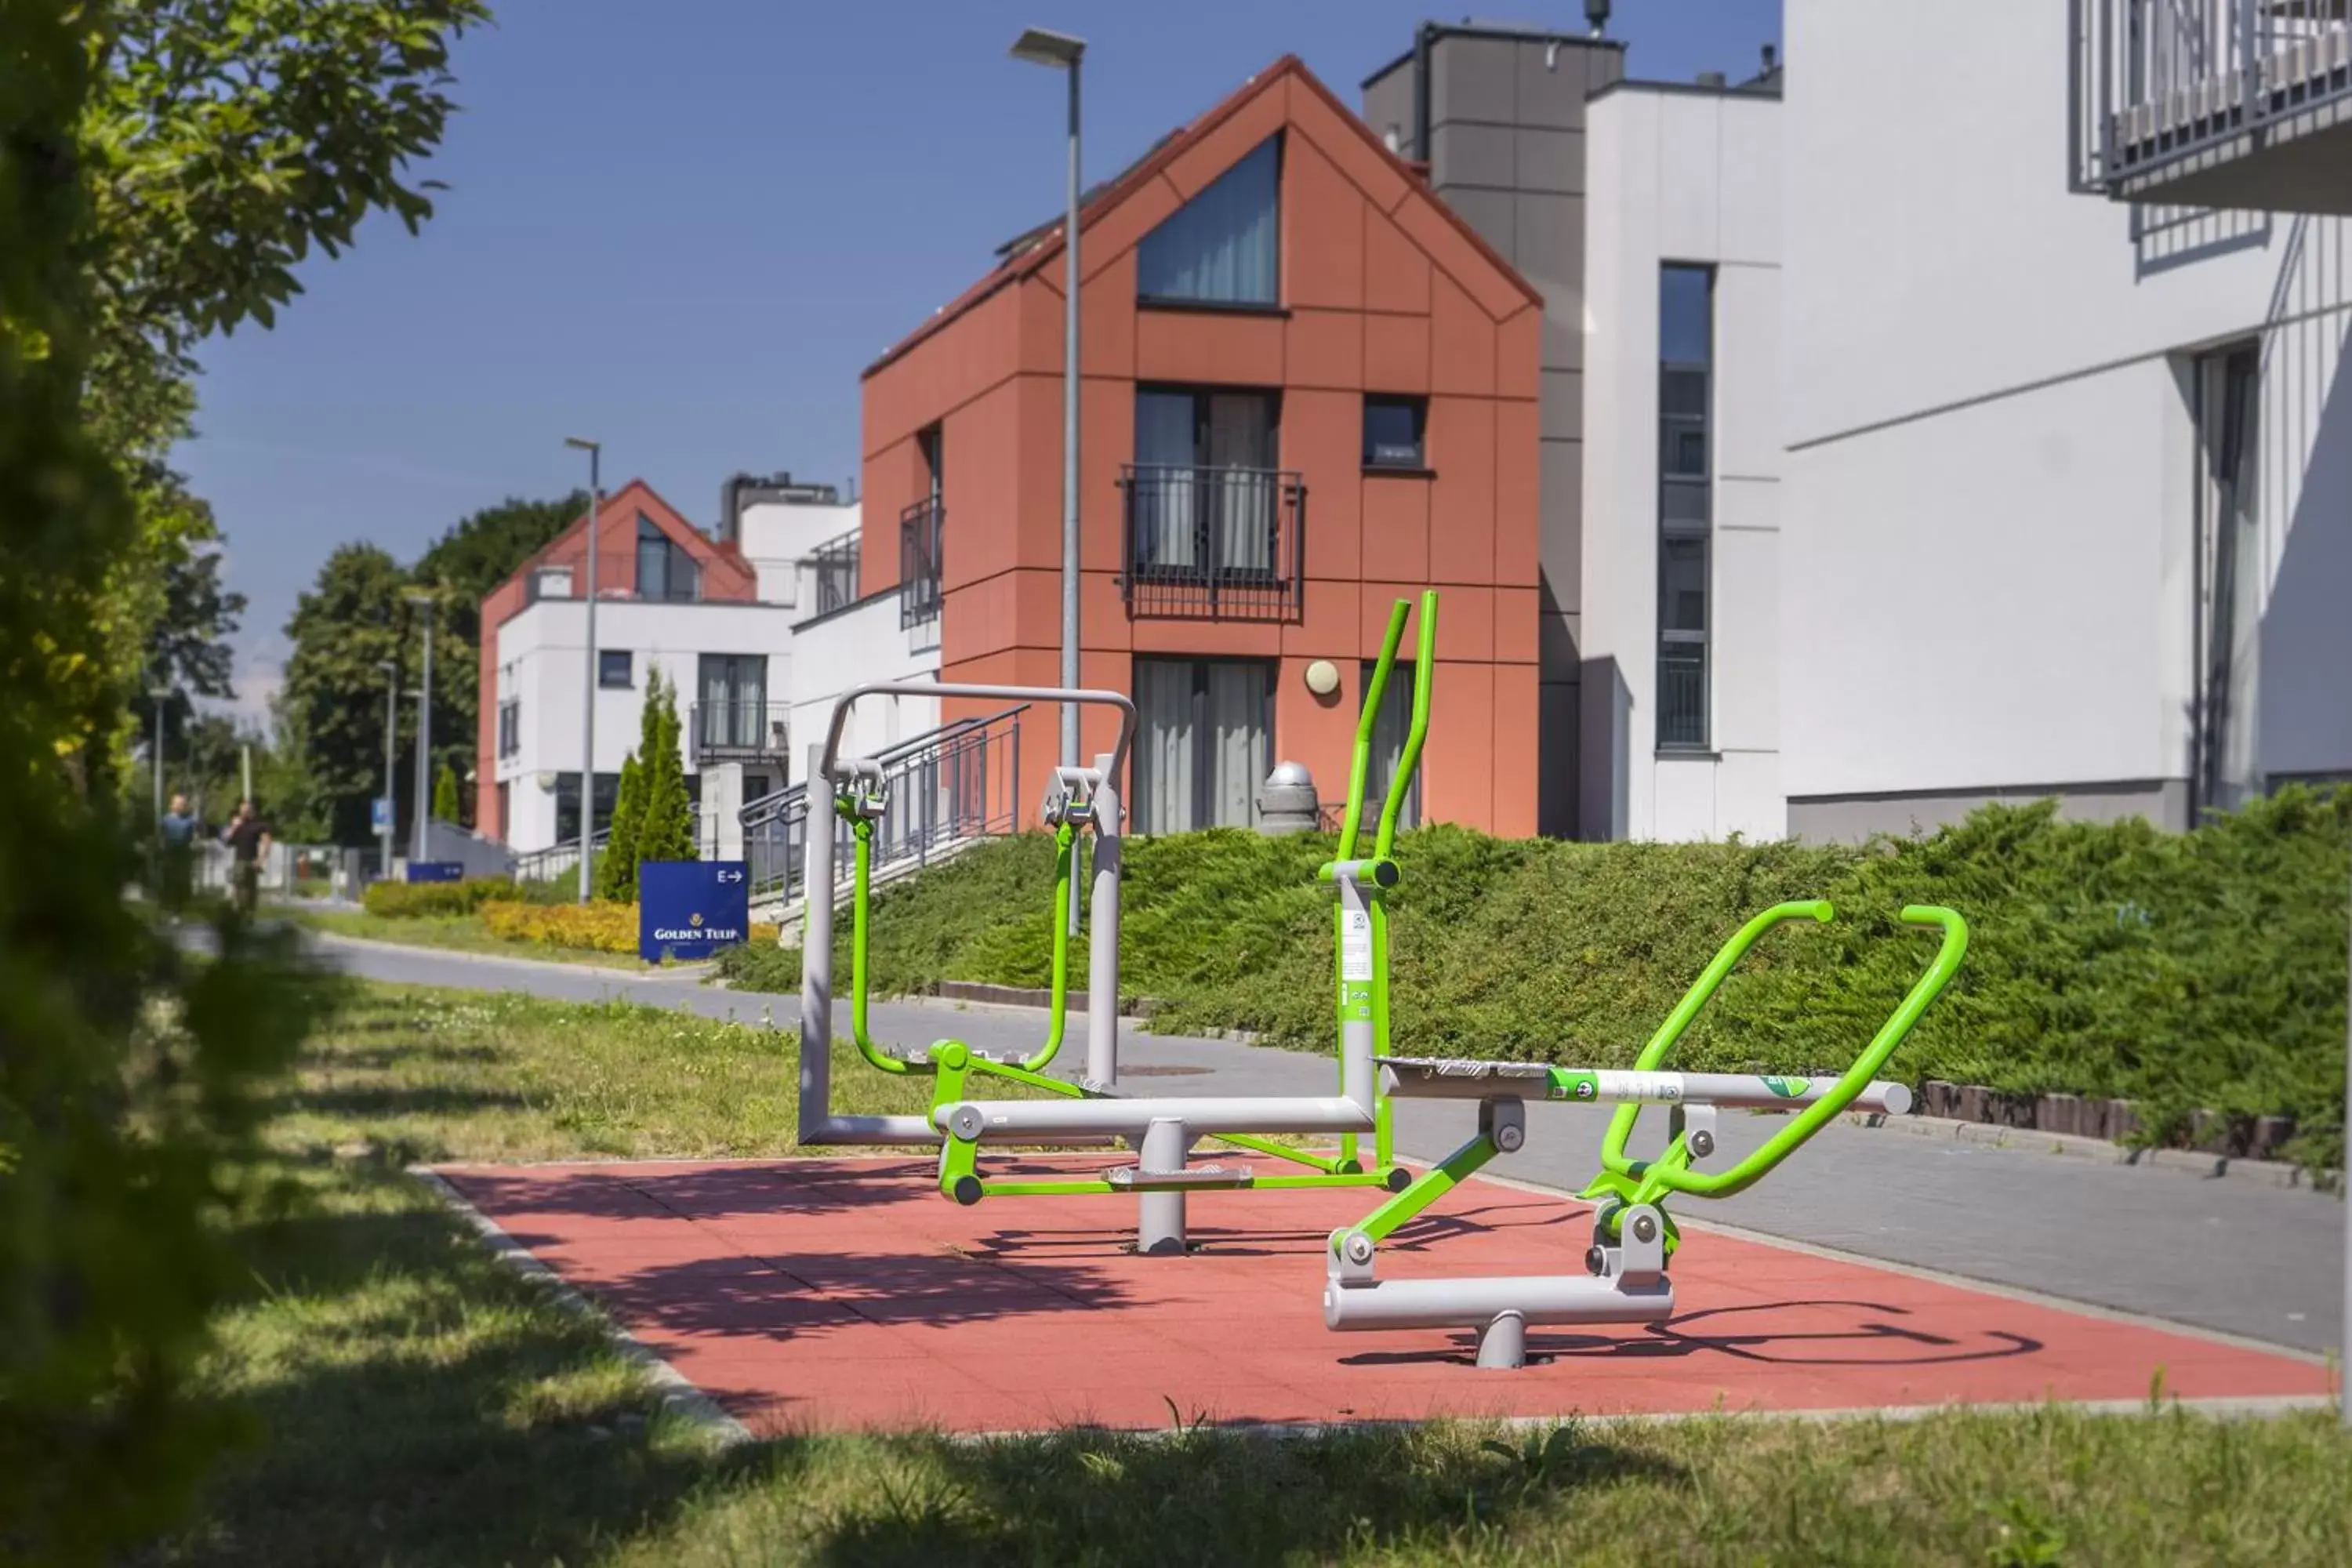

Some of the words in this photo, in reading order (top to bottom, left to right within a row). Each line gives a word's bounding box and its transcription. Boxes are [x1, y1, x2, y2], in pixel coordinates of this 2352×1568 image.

[717, 870, 726, 883] E
[654, 928, 702, 940] GOLDEN
[704, 928, 738, 940] TULIP
